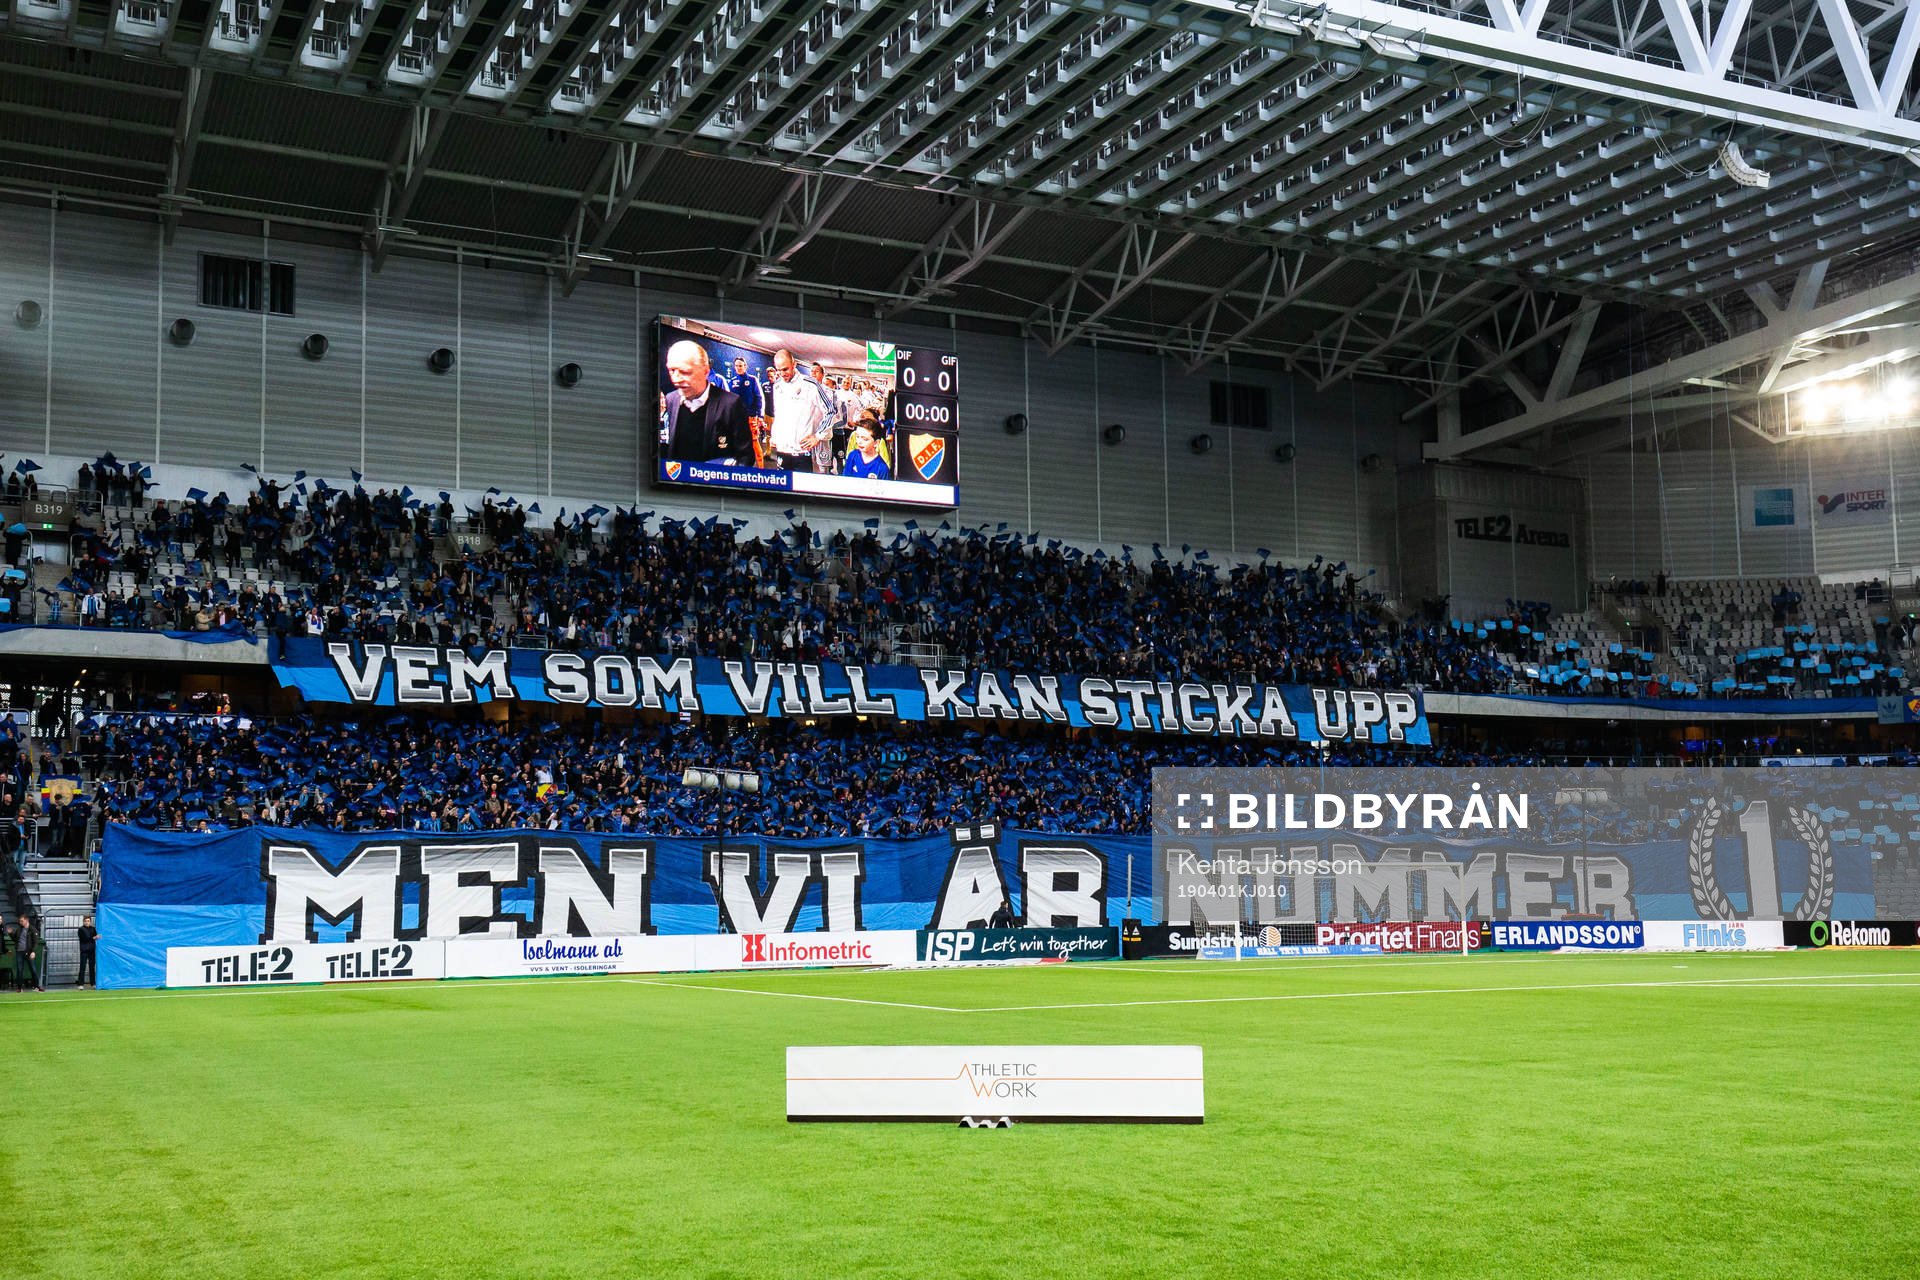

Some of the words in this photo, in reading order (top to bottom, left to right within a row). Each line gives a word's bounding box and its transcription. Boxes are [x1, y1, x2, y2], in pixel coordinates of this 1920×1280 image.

[897, 350, 912, 360] DIF
[941, 355, 956, 366] GIF
[903, 367, 916, 387] 0
[938, 371, 950, 391] 0
[905, 403, 950, 423] 00:00
[690, 467, 729, 482] Dagens
[1846, 500, 1887, 513] SPORT
[1847, 490, 1885, 502] INTER
[35, 504, 63, 515] B319
[1455, 515, 1512, 543] TELE2
[1515, 524, 1570, 548] Arena
[328, 642, 515, 704] VEM
[544, 653, 700, 711] SOM
[724, 661, 895, 715] VILL
[920, 669, 1068, 721] KAN
[1080, 677, 1297, 737] STICKA
[1312, 688, 1417, 741] UPP
[267, 843, 649, 944] MEN
[710, 852, 862, 934] VI
[937, 824, 1104, 930] ÄR
[1166, 844, 1640, 926] NUMMER
[1740, 800, 1783, 920] 1
[1317, 926, 1415, 949] Prioritet
[1416, 925, 1479, 948] Finans
[1682, 924, 1747, 947] Flinks
[1831, 921, 1890, 946] Rekomo
[523, 939, 599, 960] Isolmann
[604, 938, 623, 958] ab
[769, 940, 872, 961] Infometric
[925, 931, 976, 961] ISP
[981, 935, 1017, 954] Let's
[1020, 937, 1044, 952] win
[1048, 936, 1108, 960] together
[201, 947, 293, 983] TELE2
[326, 944, 413, 979] TELE2
